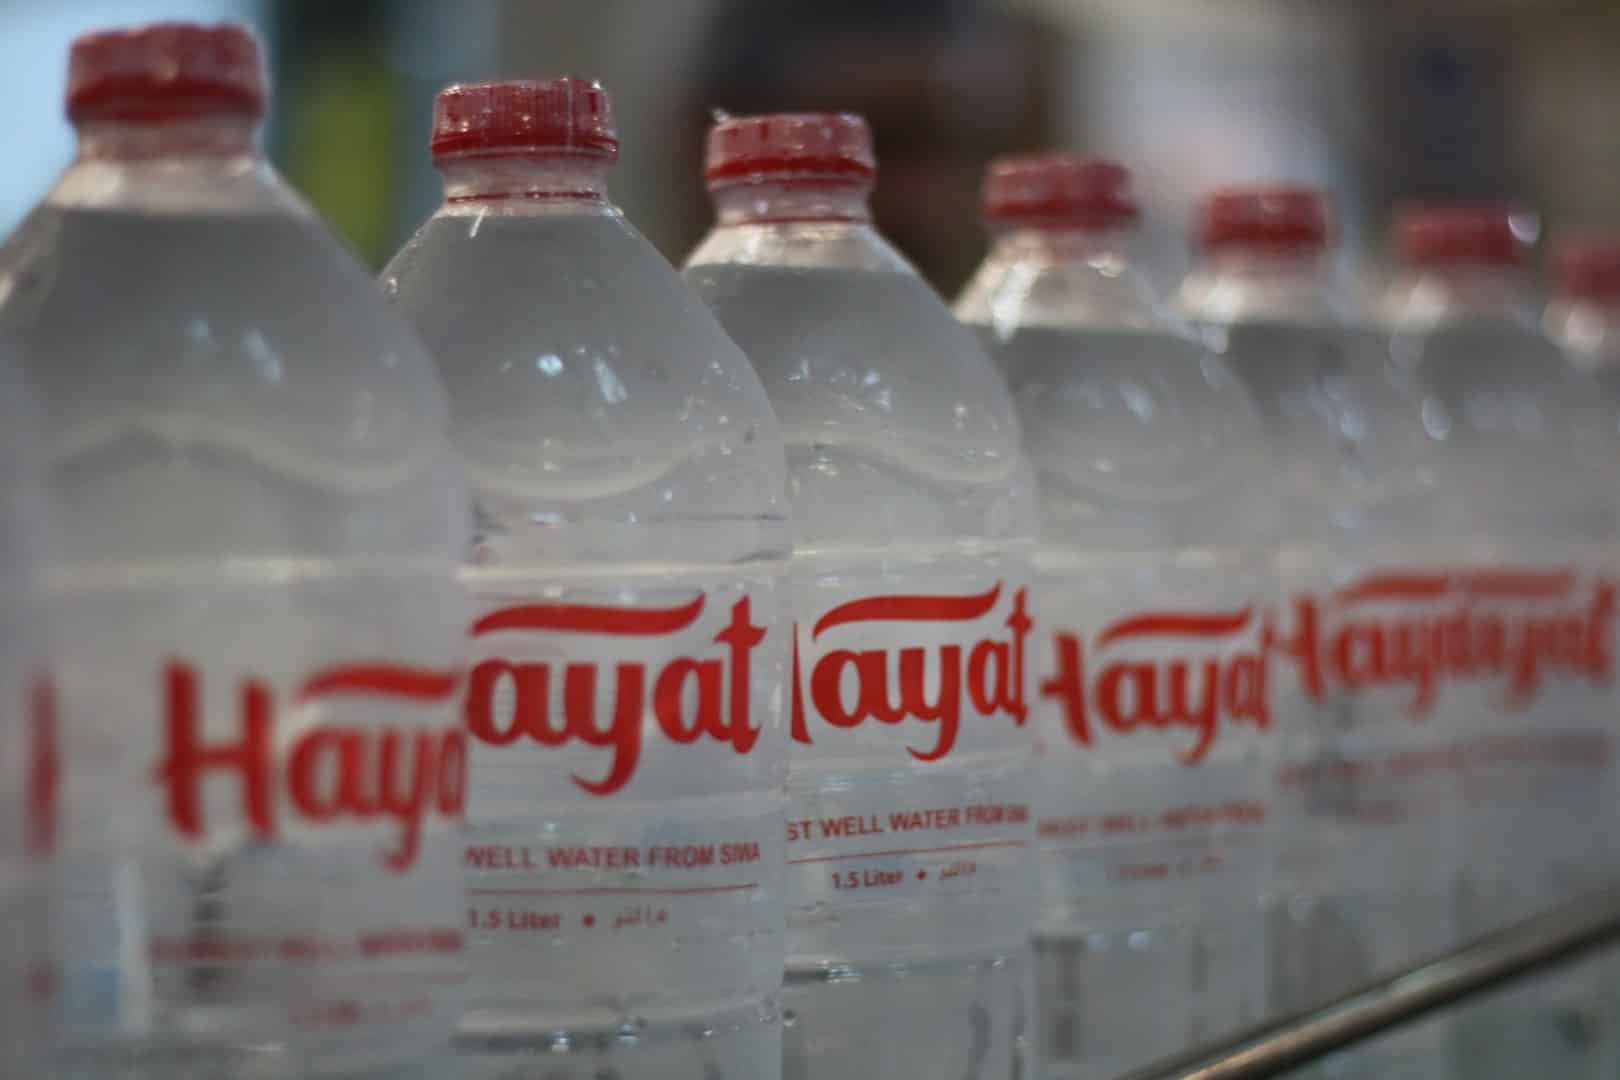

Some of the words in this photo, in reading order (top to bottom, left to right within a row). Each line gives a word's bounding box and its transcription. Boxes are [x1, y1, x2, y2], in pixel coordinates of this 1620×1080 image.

[820, 815, 883, 839] WELL
[889, 808, 961, 832] WATER
[547, 846, 640, 870] WATER
[647, 844, 715, 868] FROM
[832, 870, 860, 890] 1.5
[863, 868, 905, 889] Liter
[507, 908, 561, 930] Liter
